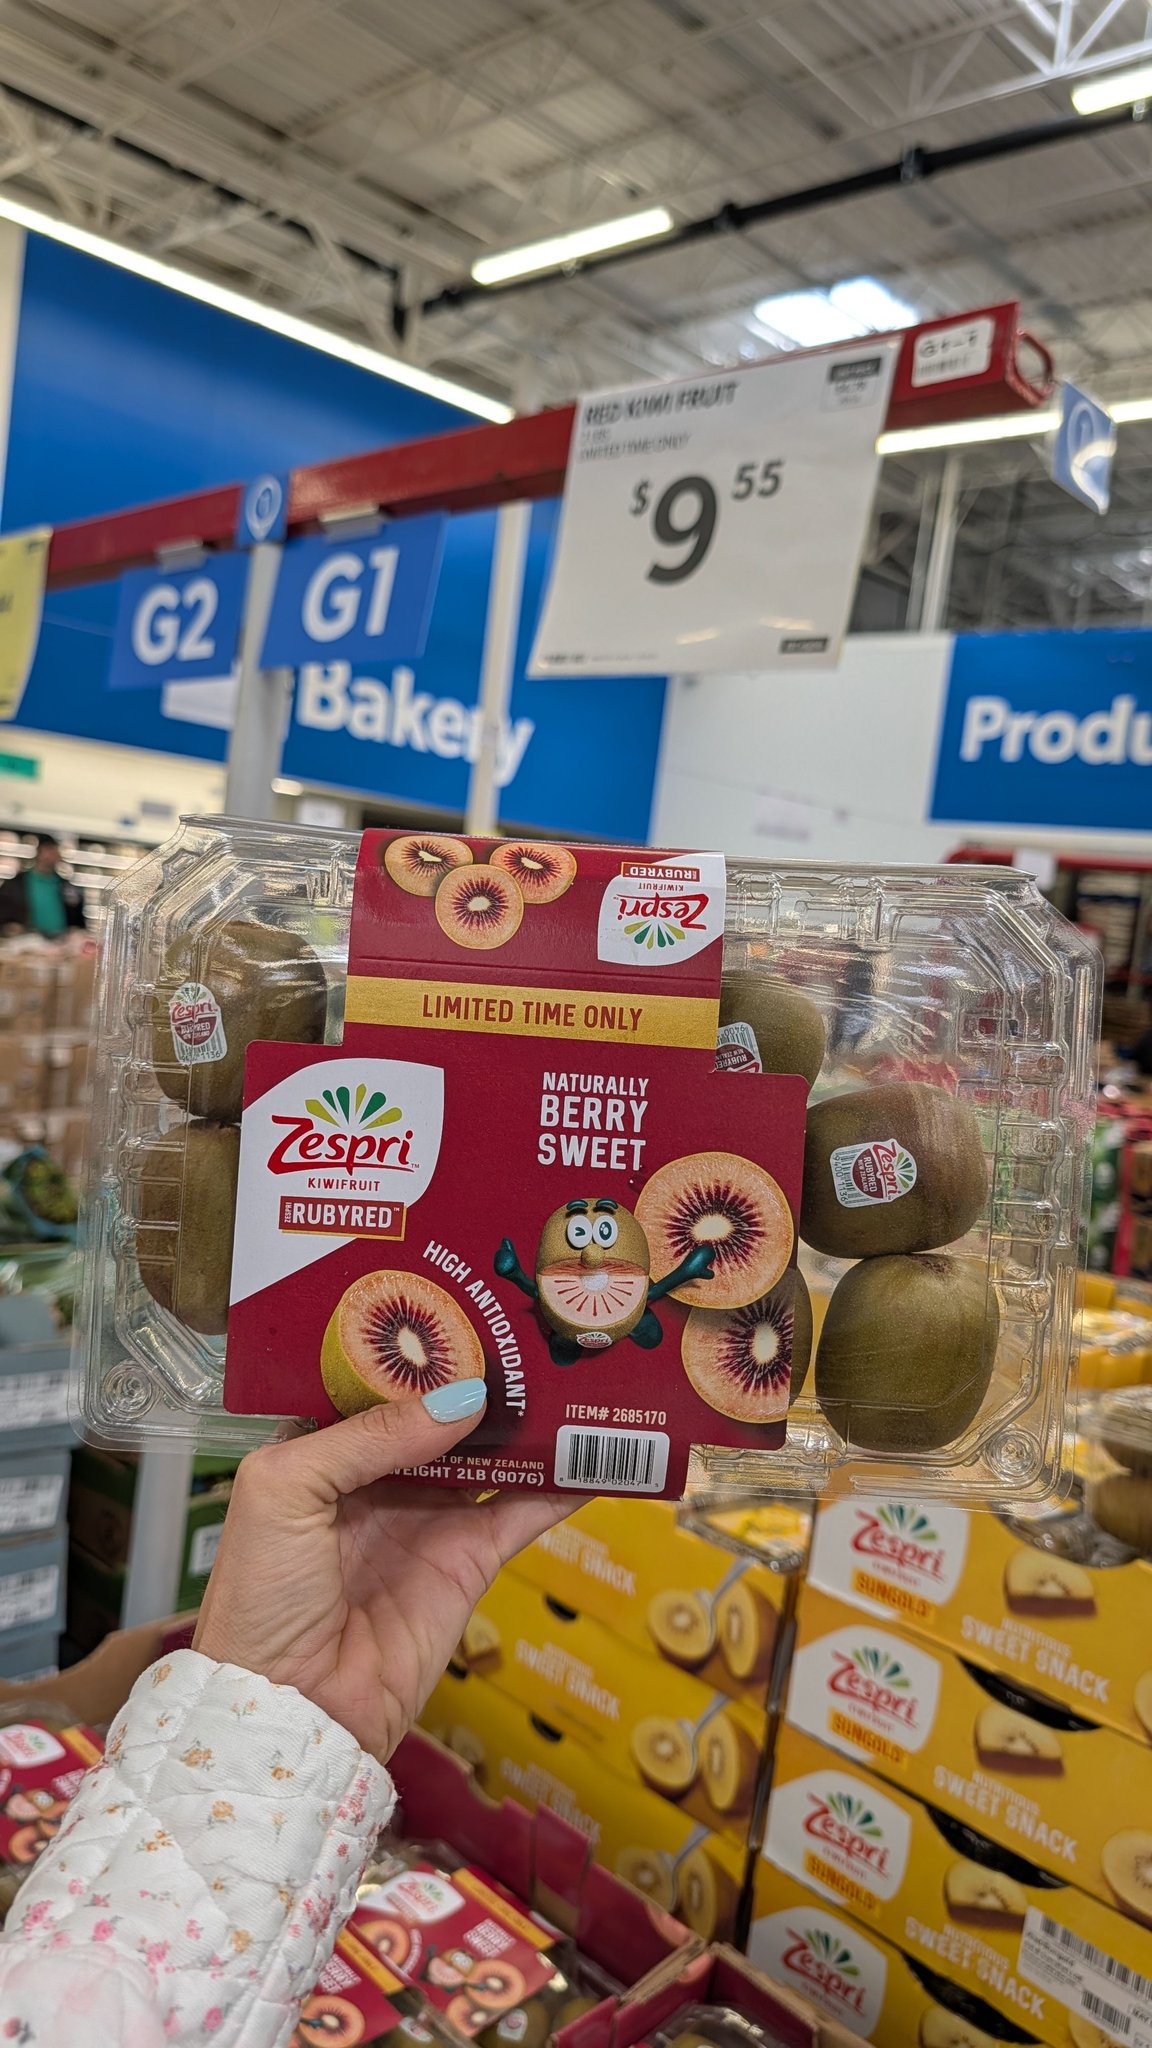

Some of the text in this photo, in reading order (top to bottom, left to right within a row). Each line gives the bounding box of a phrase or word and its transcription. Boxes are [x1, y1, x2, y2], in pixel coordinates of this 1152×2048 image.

[675, 380, 741, 412] FRUIT
[629, 458, 784, 586] $ 9 55
[301, 546, 400, 643] G1
[131, 577, 219, 666] G2
[297, 660, 536, 787] Bakery
[629, 866, 692, 880] RUBYRED
[638, 882, 684, 892] KIWIFRUIT
[616, 892, 709, 930] Zespri
[422, 994, 643, 1031] LIMITED TIME ONLY
[542, 1071, 650, 1097] NATURALLY
[540, 1094, 649, 1133] BERRY
[267, 1114, 415, 1177] Zespri
[537, 1133, 647, 1171] SWEET
[308, 1178, 381, 1192] KIWIFRUIT
[863, 1156, 877, 1192] RUBYRED
[872, 1142, 901, 1197] Zespri
[292, 1202, 392, 1229] RUBYRED
[422, 1239, 472, 1284] HIGH
[565, 1404, 667, 1426] ITEM# 2685170
[450, 1456, 464, 1465] OF
[467, 1457, 491, 1466] NEW
[495, 1459, 544, 1470] ZEALAND
[457, 1468, 486, 1481] 2LB
[491, 1469, 544, 1487] (907G)
[851, 1509, 945, 1583] Zespri
[960, 1615, 1111, 1705] SWEET SNACK
[828, 1649, 920, 1729] Zespri
[803, 1791, 890, 1880] Zespri
[933, 1764, 1078, 1865] SWEET SNACK
[782, 1926, 868, 2018] Zespri
[905, 1915, 972, 1969] SWEET
[977, 1957, 1045, 2021] SNACK
